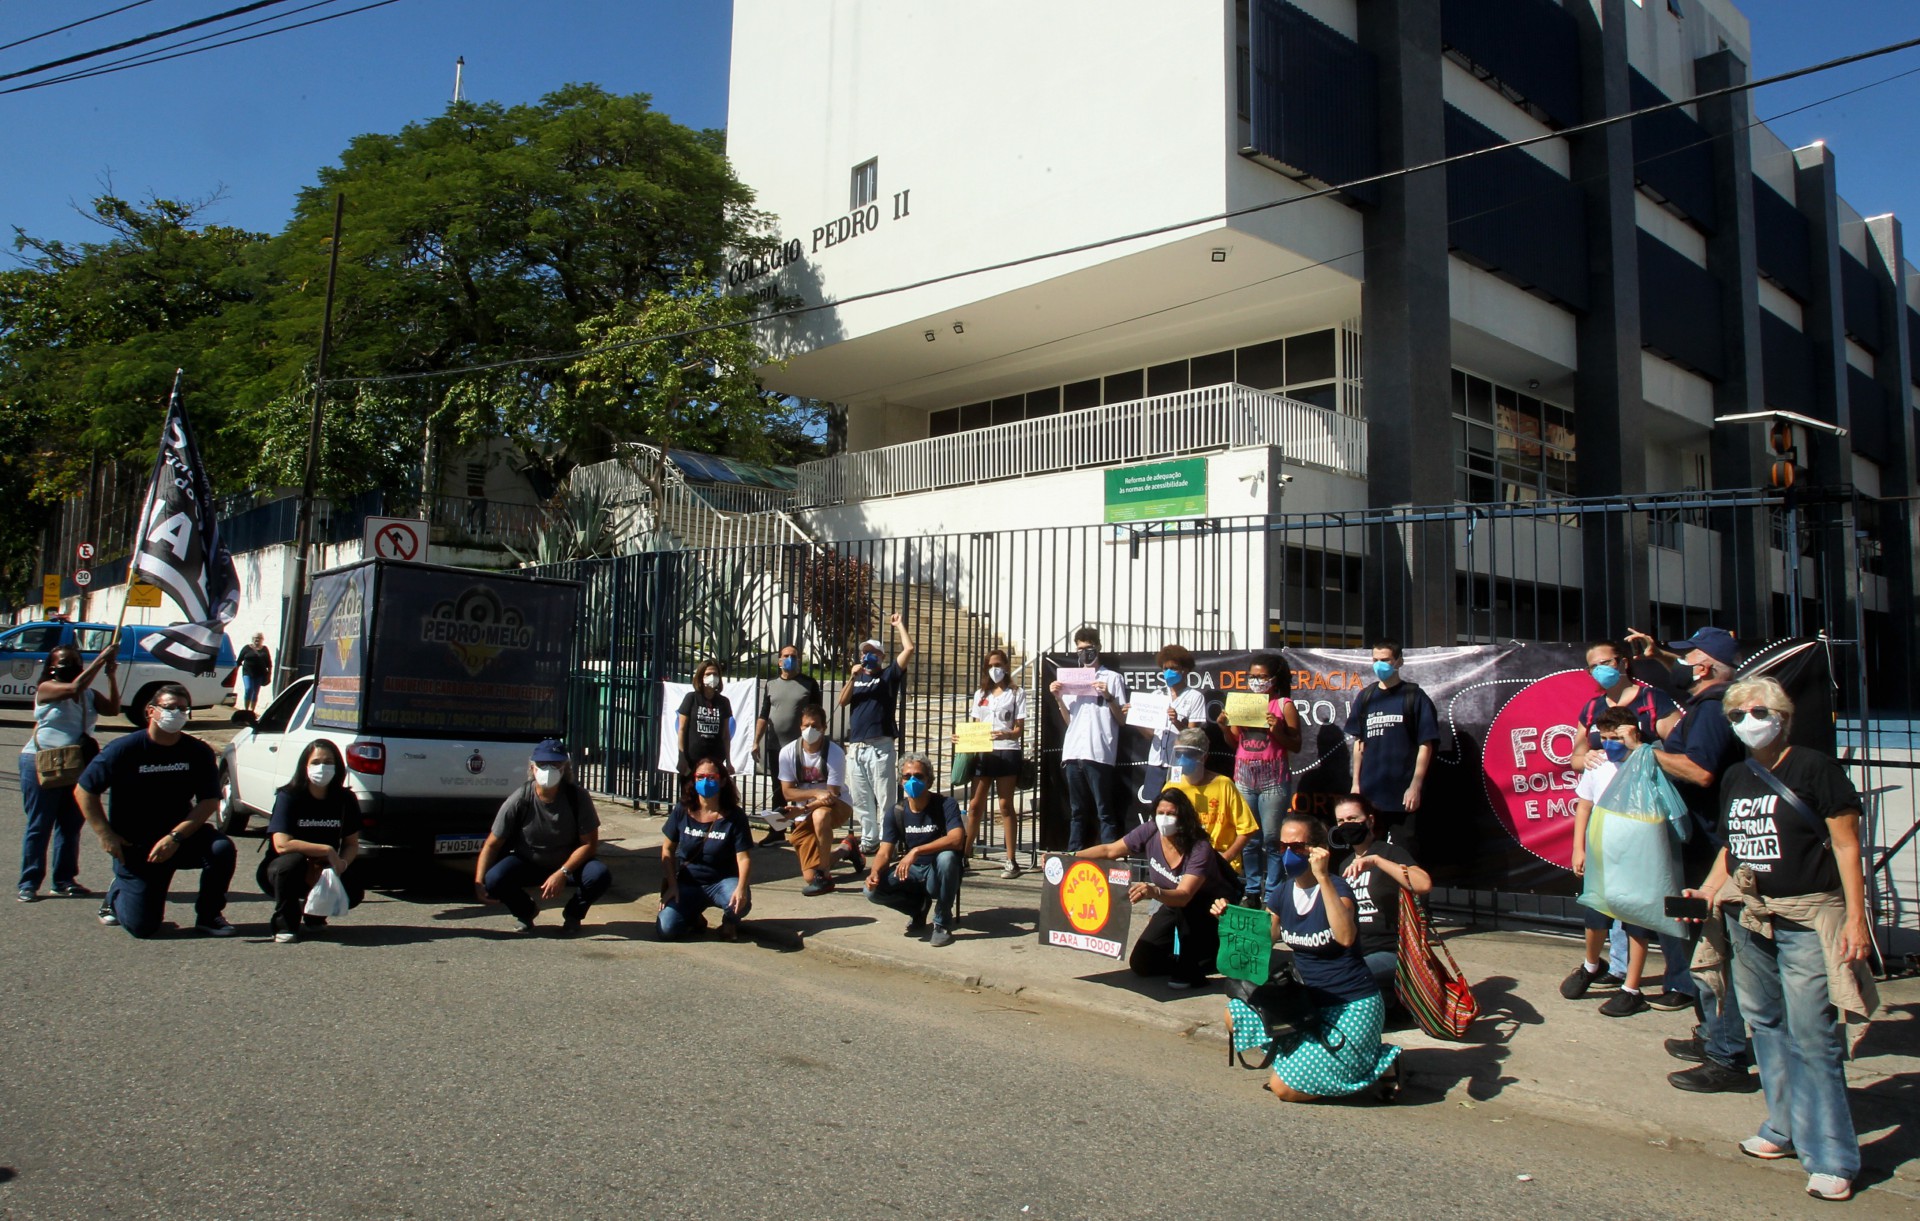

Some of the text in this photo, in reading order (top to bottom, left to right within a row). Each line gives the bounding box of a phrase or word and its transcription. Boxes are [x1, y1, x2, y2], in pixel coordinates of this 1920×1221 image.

[812, 205, 880, 254] PEDRO
[893, 189, 911, 221] II
[1152, 481, 1188, 489] acessibilidade
[1153, 472, 1181, 480] adequação
[78, 572, 89, 580] 30
[423, 620, 530, 648] PEDRO MELO
[1187, 670, 1215, 690] DA
[440, 776, 509, 786] WORKING
[1525, 800, 1541, 819] E
[1737, 795, 1778, 817] CPII
[1746, 817, 1778, 835] RUA
[1732, 838, 1779, 856] LUTAR
[1067, 869, 1105, 898] VACINA
[1077, 900, 1098, 920] JÁ
[1229, 912, 1260, 935] LUTE
[1052, 932, 1079, 947] PARA
